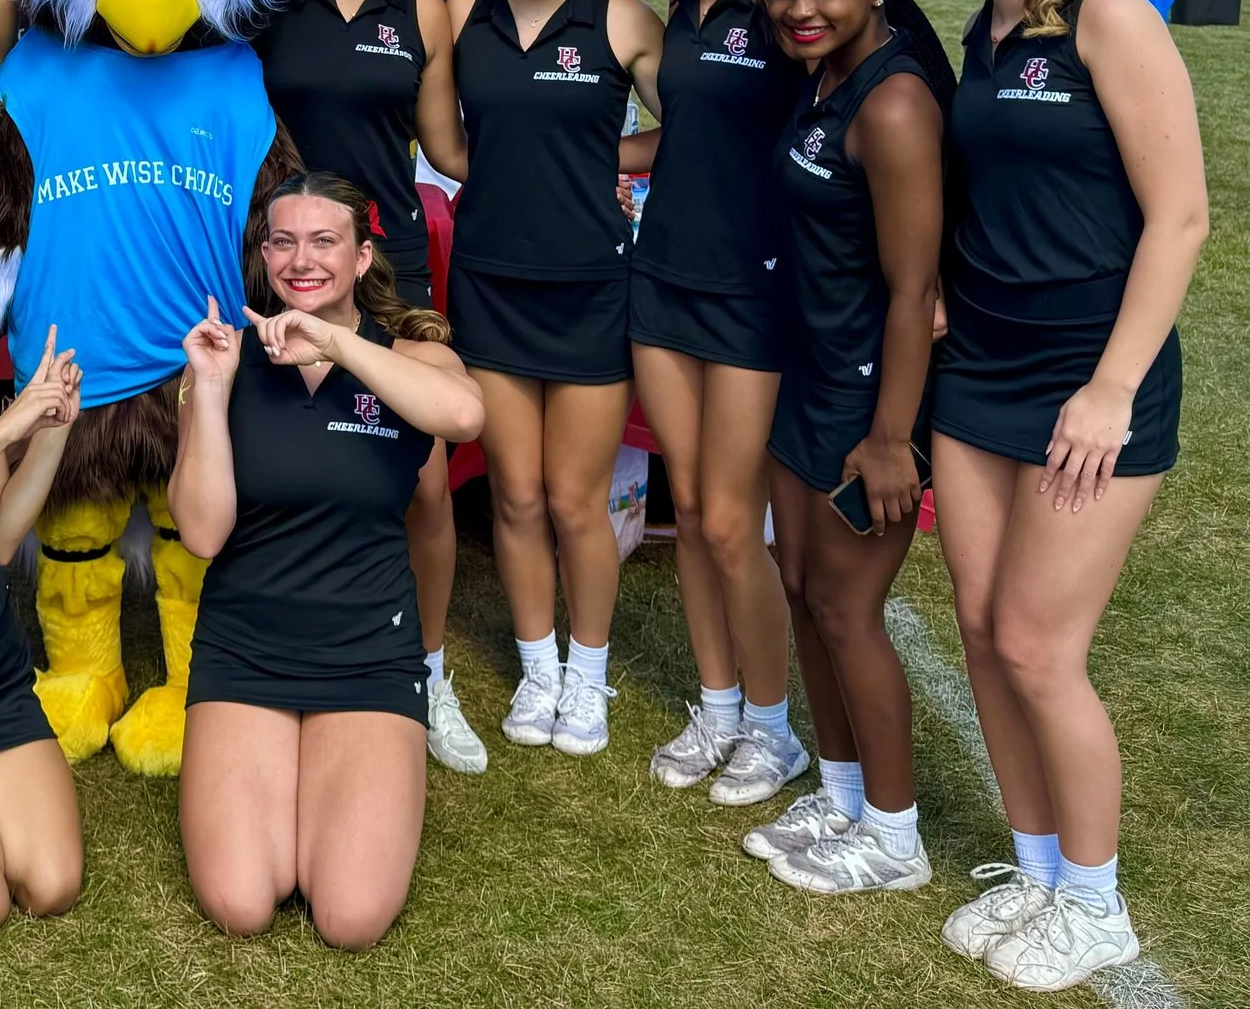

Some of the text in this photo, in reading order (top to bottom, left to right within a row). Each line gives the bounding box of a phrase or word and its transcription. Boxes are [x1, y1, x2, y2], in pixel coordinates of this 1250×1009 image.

[700, 52, 767, 70] CHEERLEADING
[533, 71, 600, 84] CHEERLEADING
[37, 166, 98, 205] MAKE
[102, 160, 165, 186] WISE
[354, 394, 381, 425] HC
[327, 421, 400, 440] CHEERLEADING
